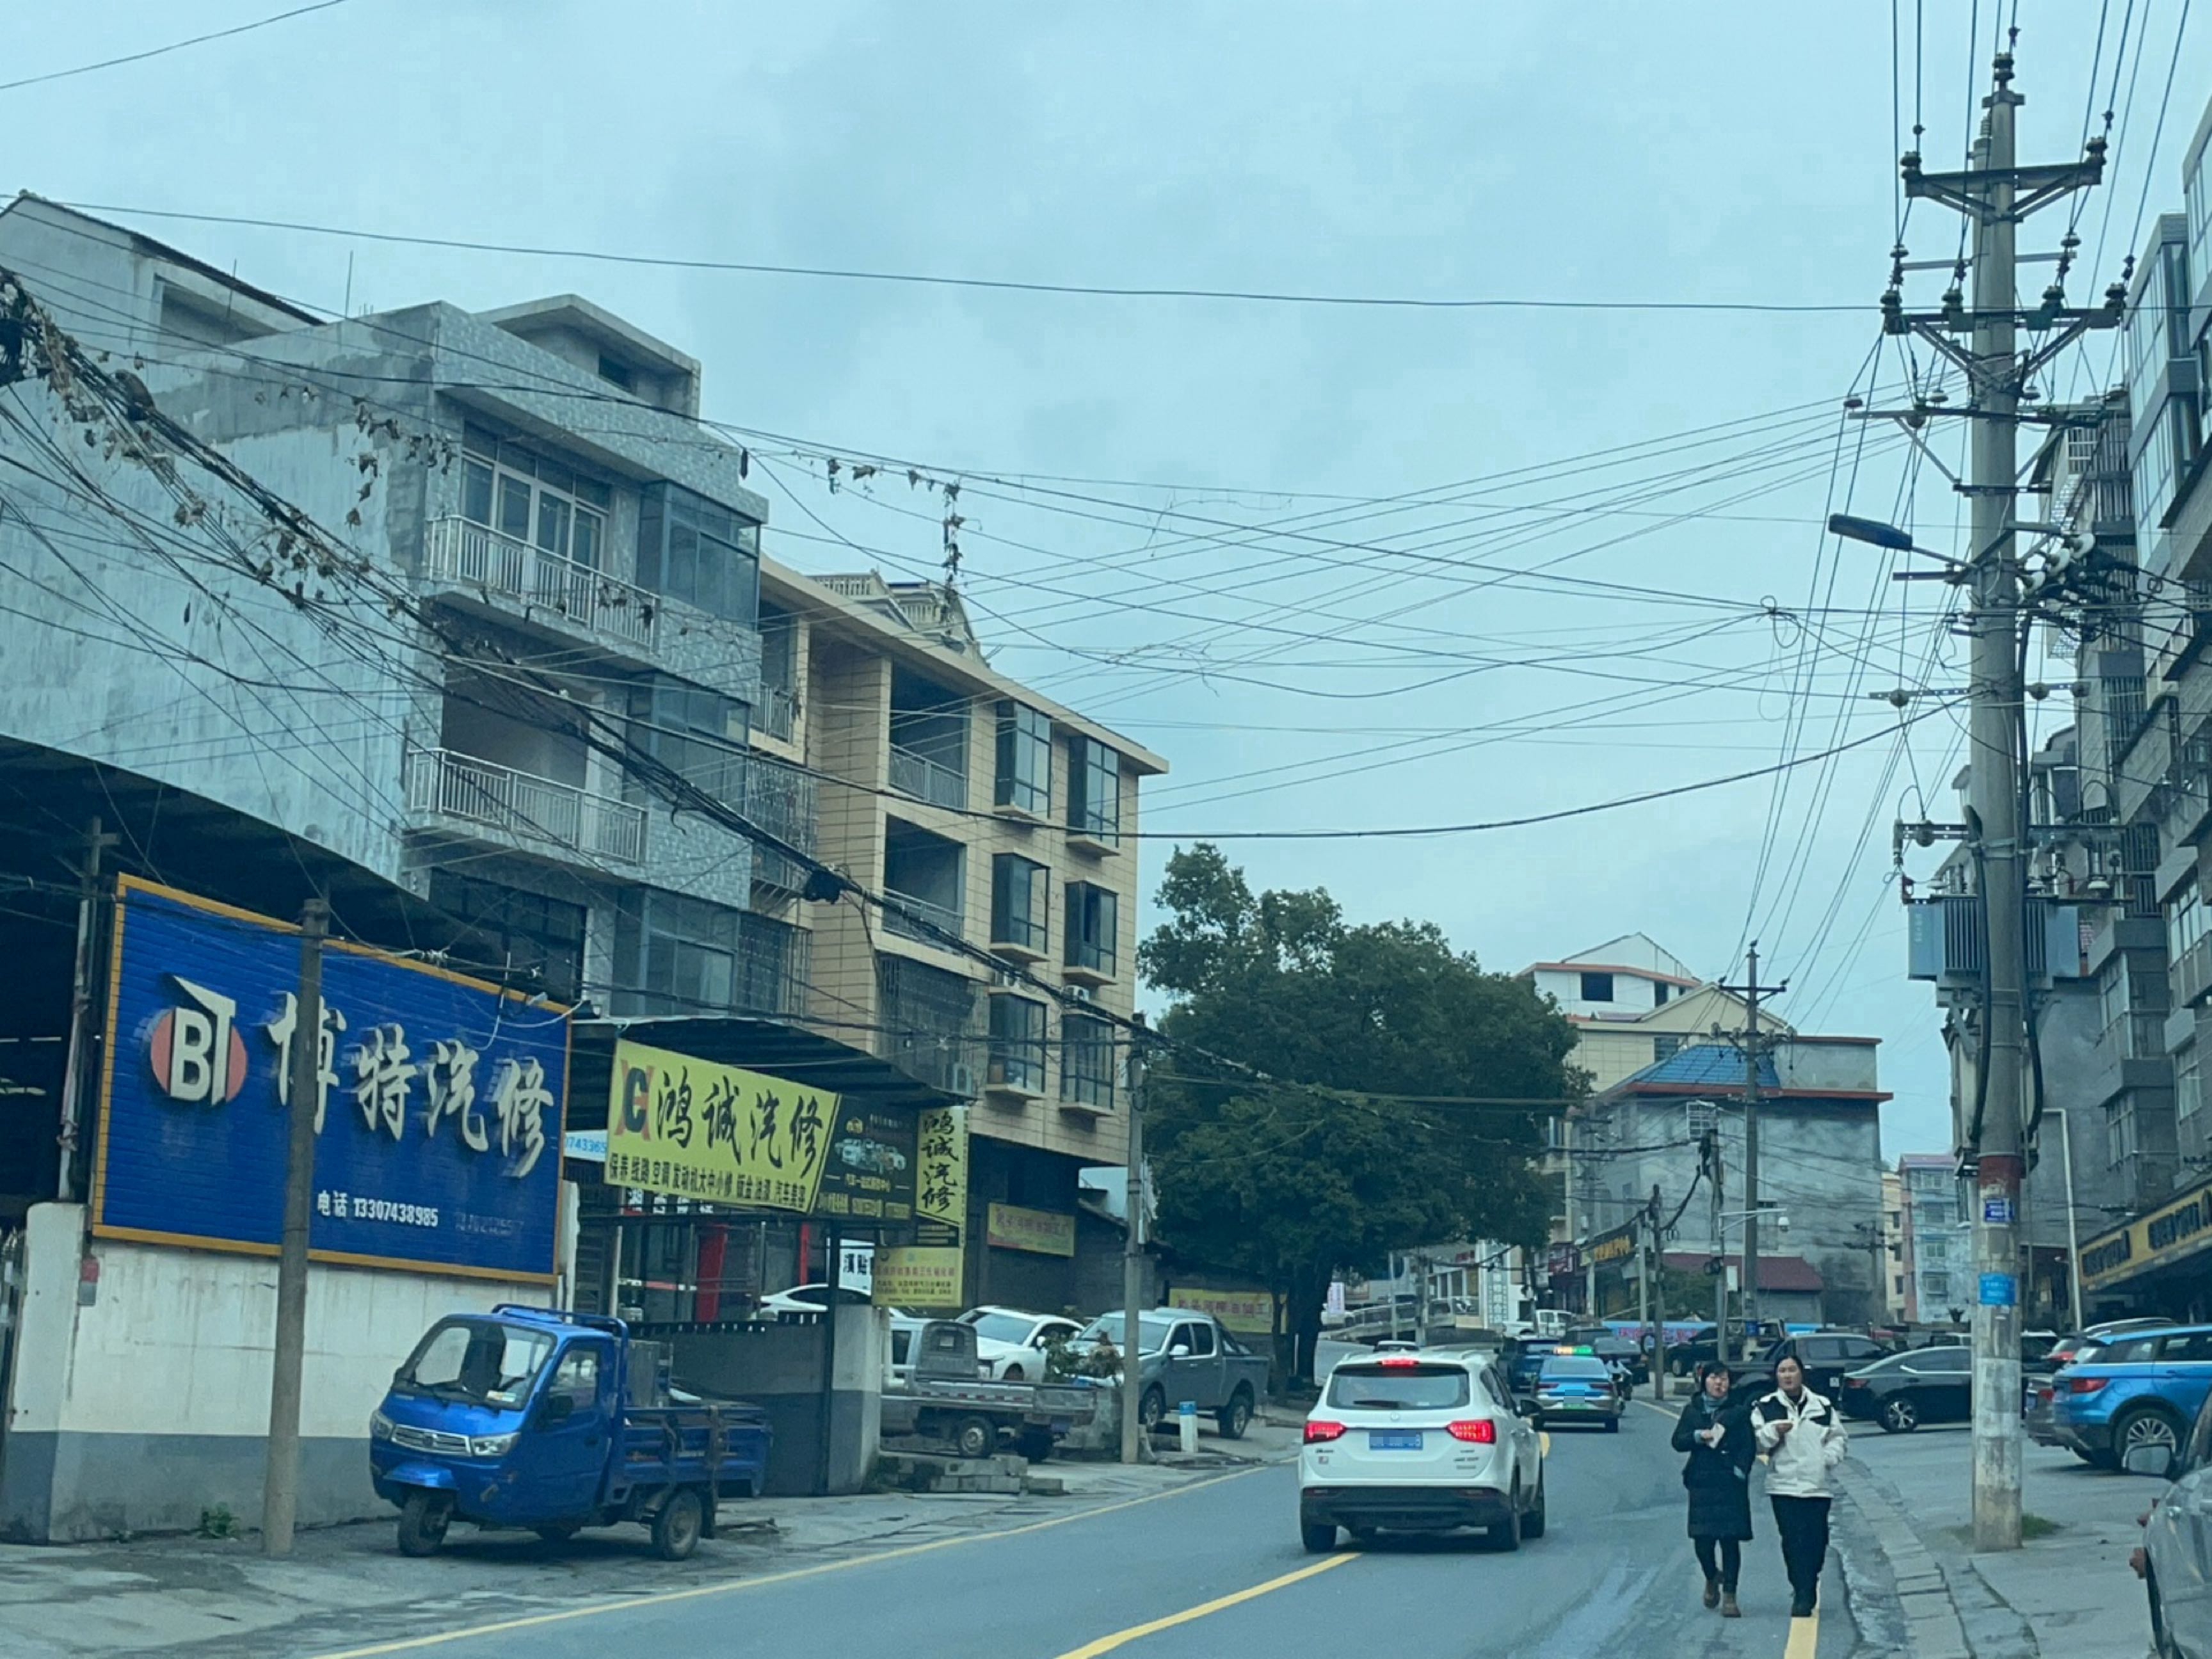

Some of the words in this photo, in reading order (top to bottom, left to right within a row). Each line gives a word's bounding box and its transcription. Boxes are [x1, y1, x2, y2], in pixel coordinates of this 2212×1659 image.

[656, 1065, 823, 1179] 鸿诚汽修
[922, 1110, 959, 1214] 鸿诚汽修
[317, 1190, 348, 1218] 电话
[353, 1198, 440, 1228] 13307438985
